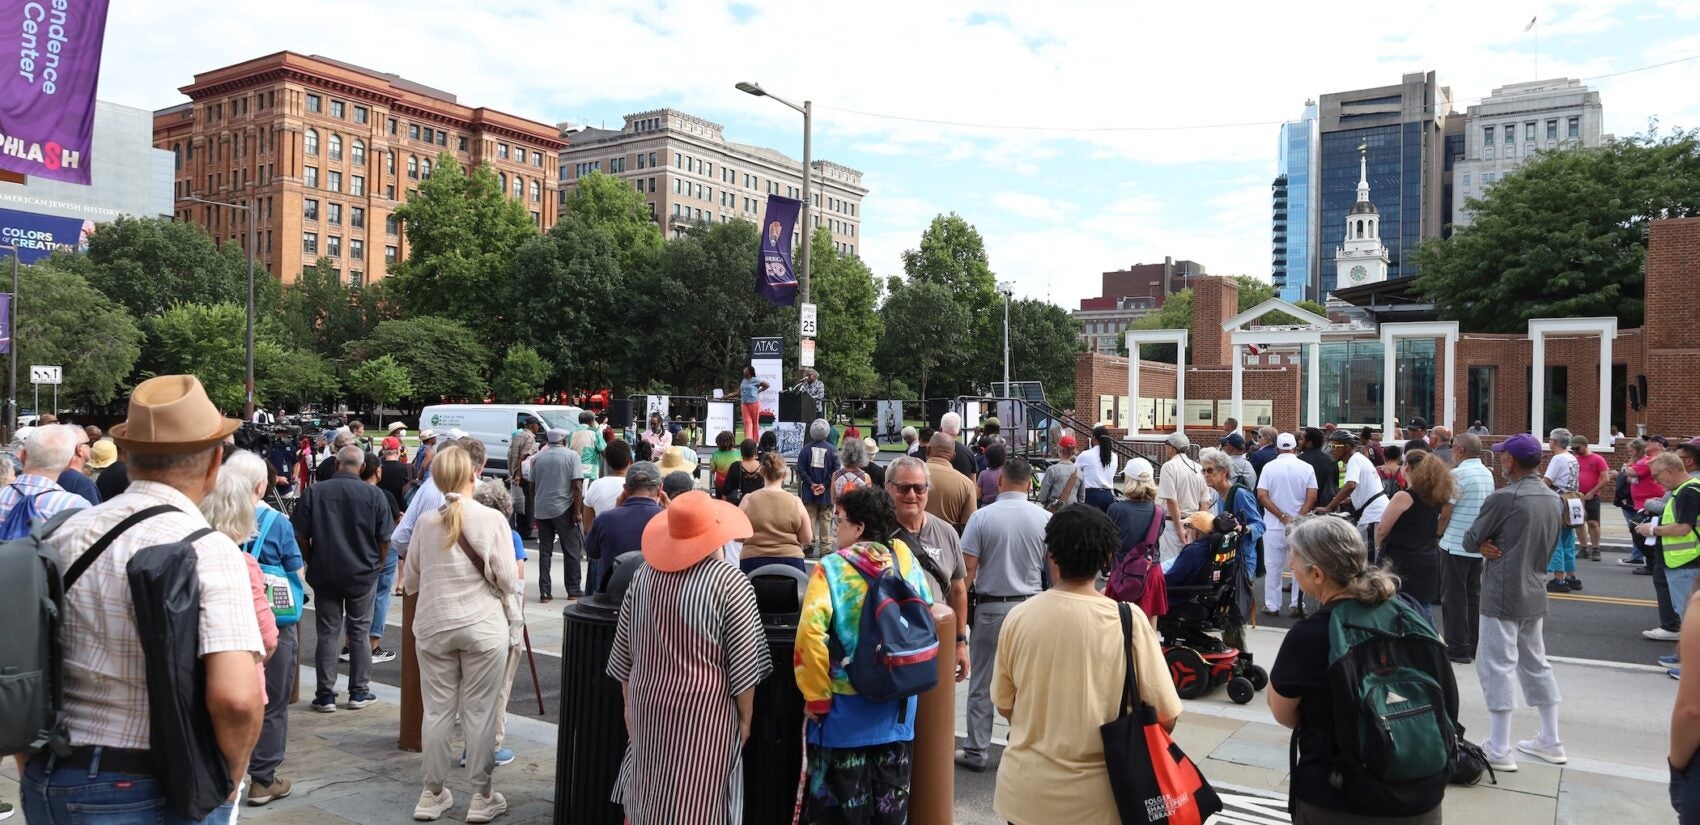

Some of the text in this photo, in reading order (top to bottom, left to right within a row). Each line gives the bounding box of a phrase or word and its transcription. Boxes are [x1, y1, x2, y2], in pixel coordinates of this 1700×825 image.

[20, 2, 46, 83] Center
[43, 0, 68, 95] endence
[49, 200, 82, 212] JEWISH
[83, 205, 121, 217] HISTORY
[2, 227, 53, 242] COLORS
[803, 320, 815, 333] 25
[754, 340, 779, 352] ATAC
[1144, 793, 1171, 806] FOLGER
[1149, 808, 1176, 822] LIBRARY
